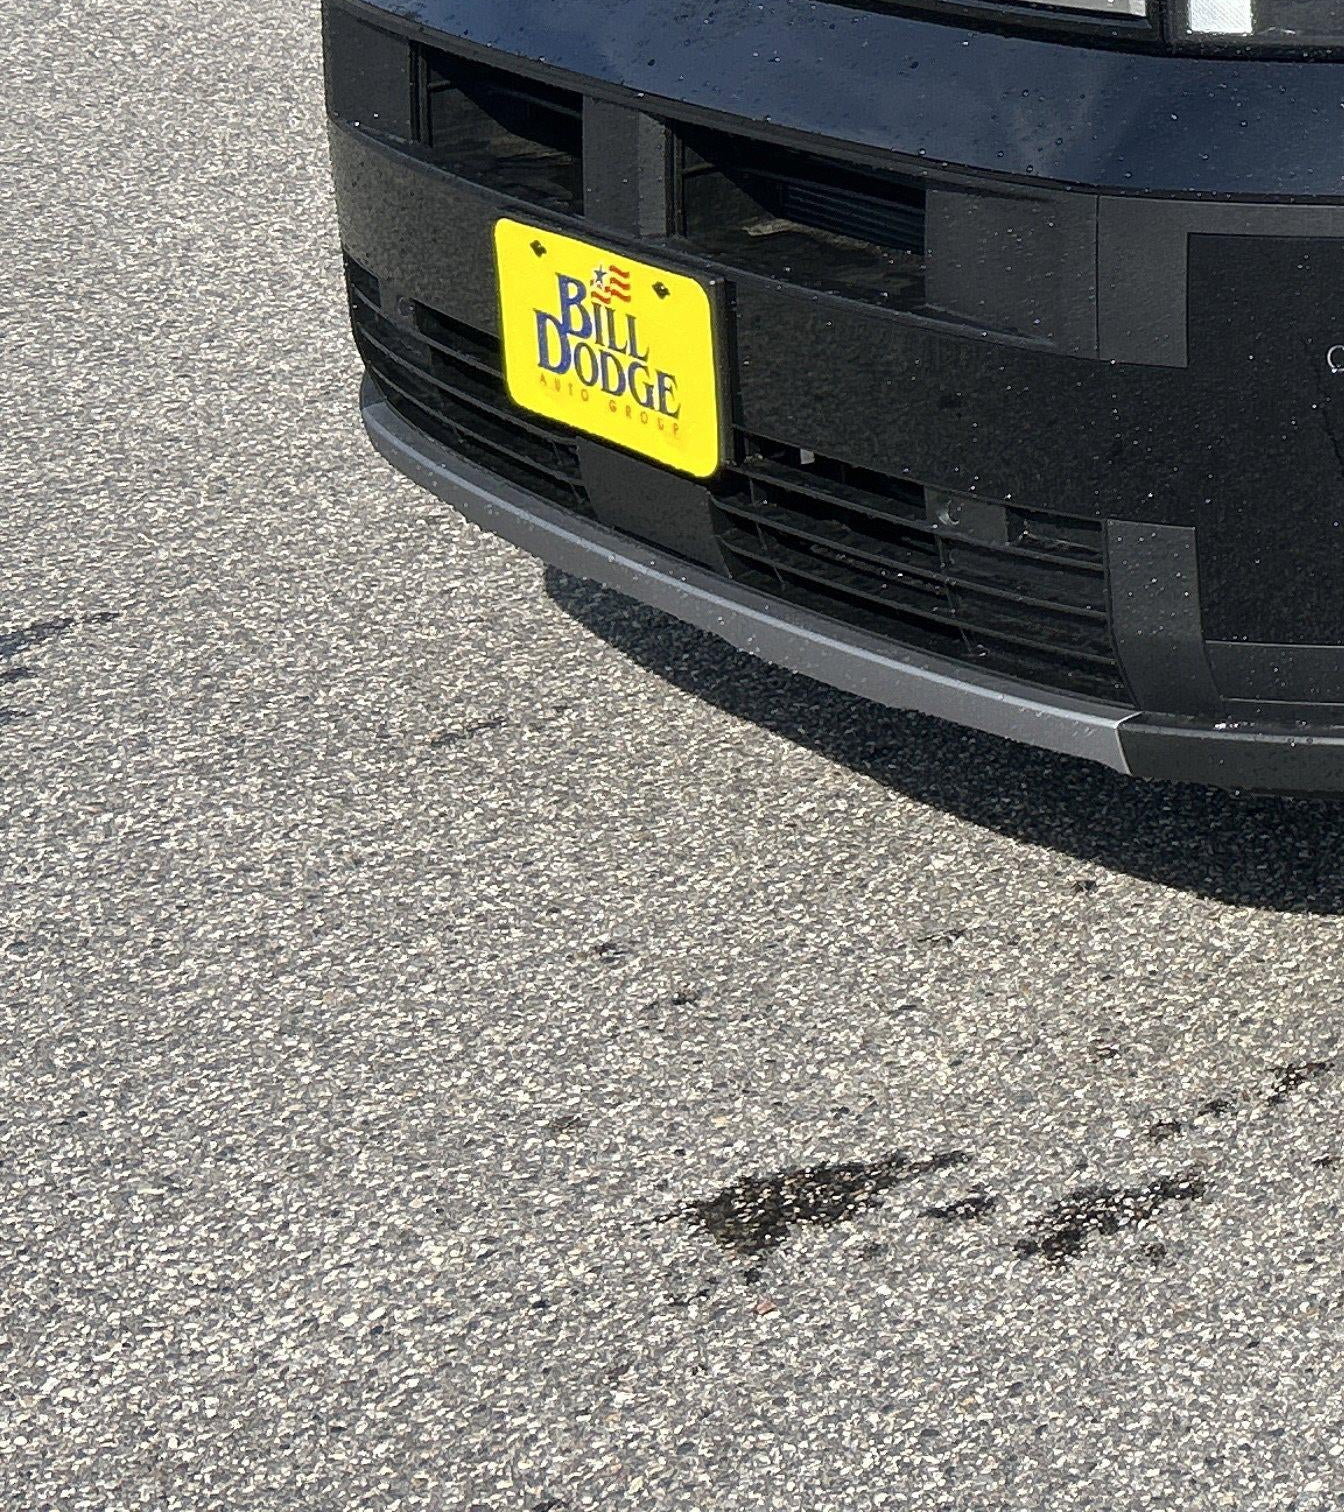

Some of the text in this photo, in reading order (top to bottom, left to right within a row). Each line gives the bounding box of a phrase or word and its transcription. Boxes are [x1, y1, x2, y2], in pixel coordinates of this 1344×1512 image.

[554, 271, 651, 363] BILL
[532, 308, 682, 419] DODGE
[538, 373, 680, 435] AUTO GROUP
